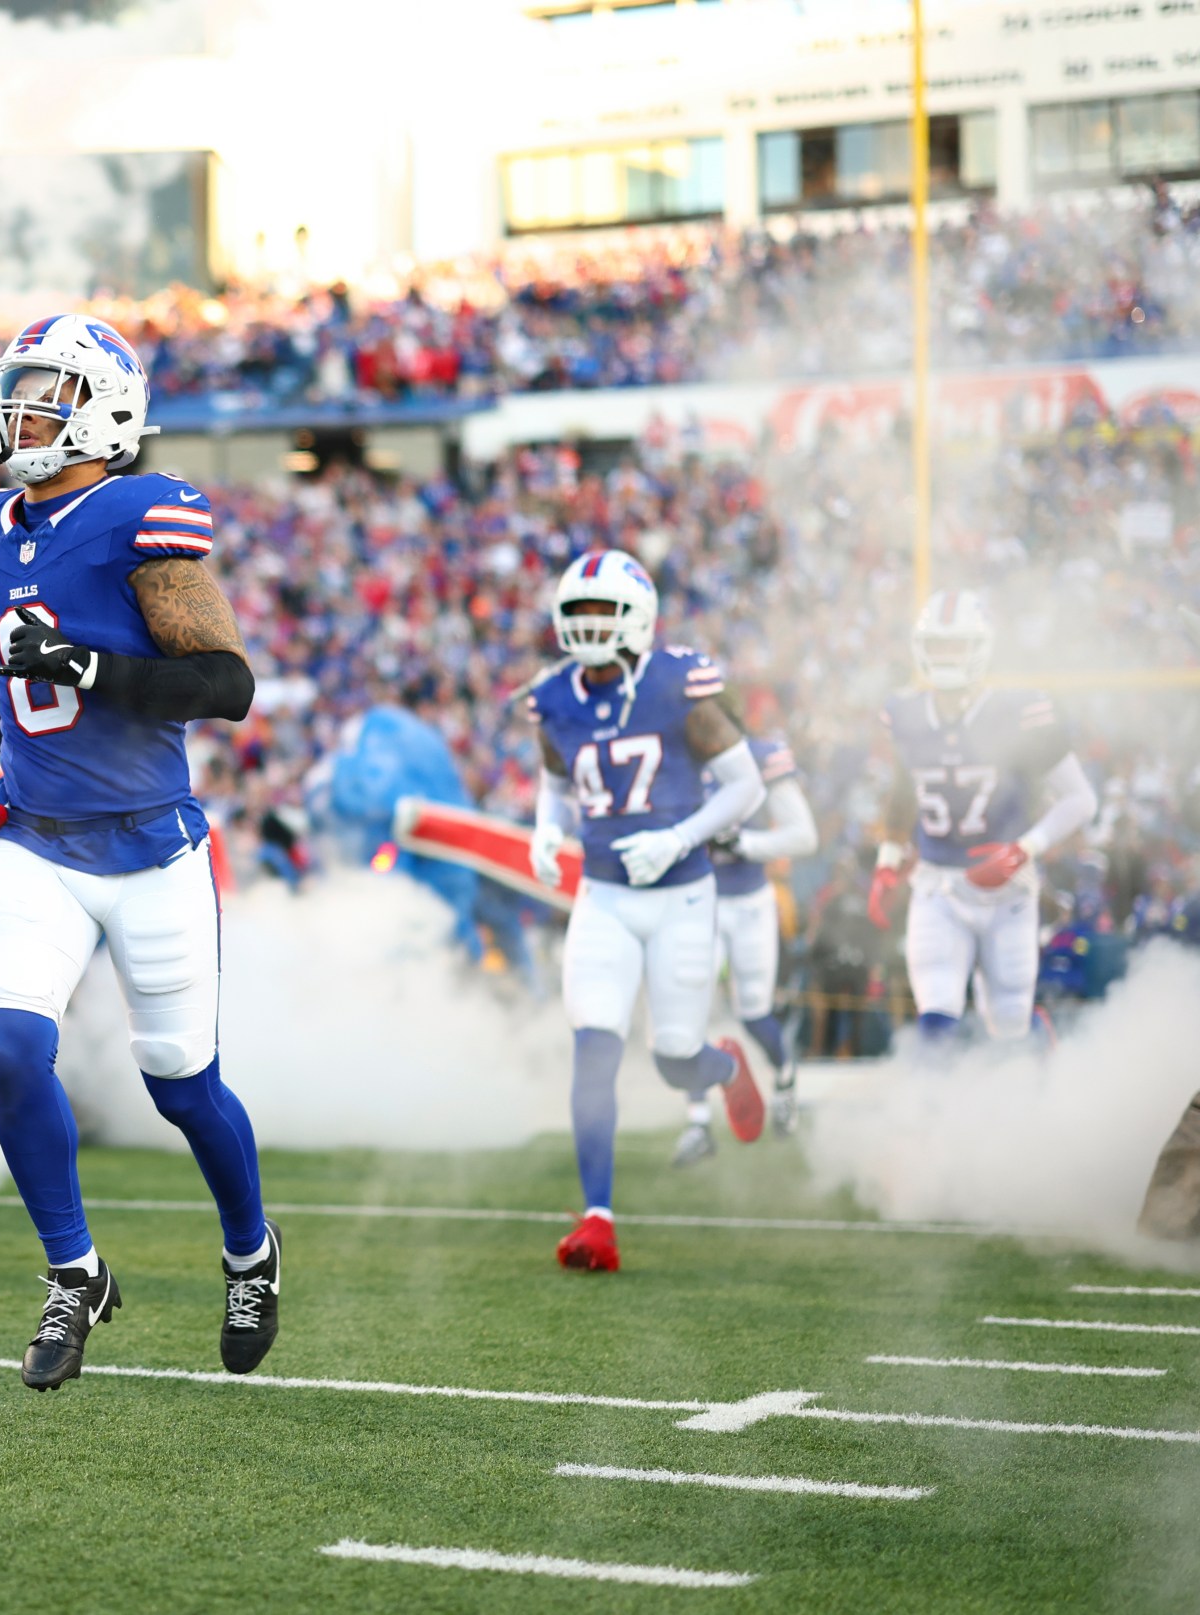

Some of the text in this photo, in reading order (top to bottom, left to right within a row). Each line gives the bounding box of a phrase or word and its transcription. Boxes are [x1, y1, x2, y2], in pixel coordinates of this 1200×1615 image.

[9, 585, 38, 600] BILLS
[574, 734, 662, 818] 47
[911, 767, 998, 837] 57
